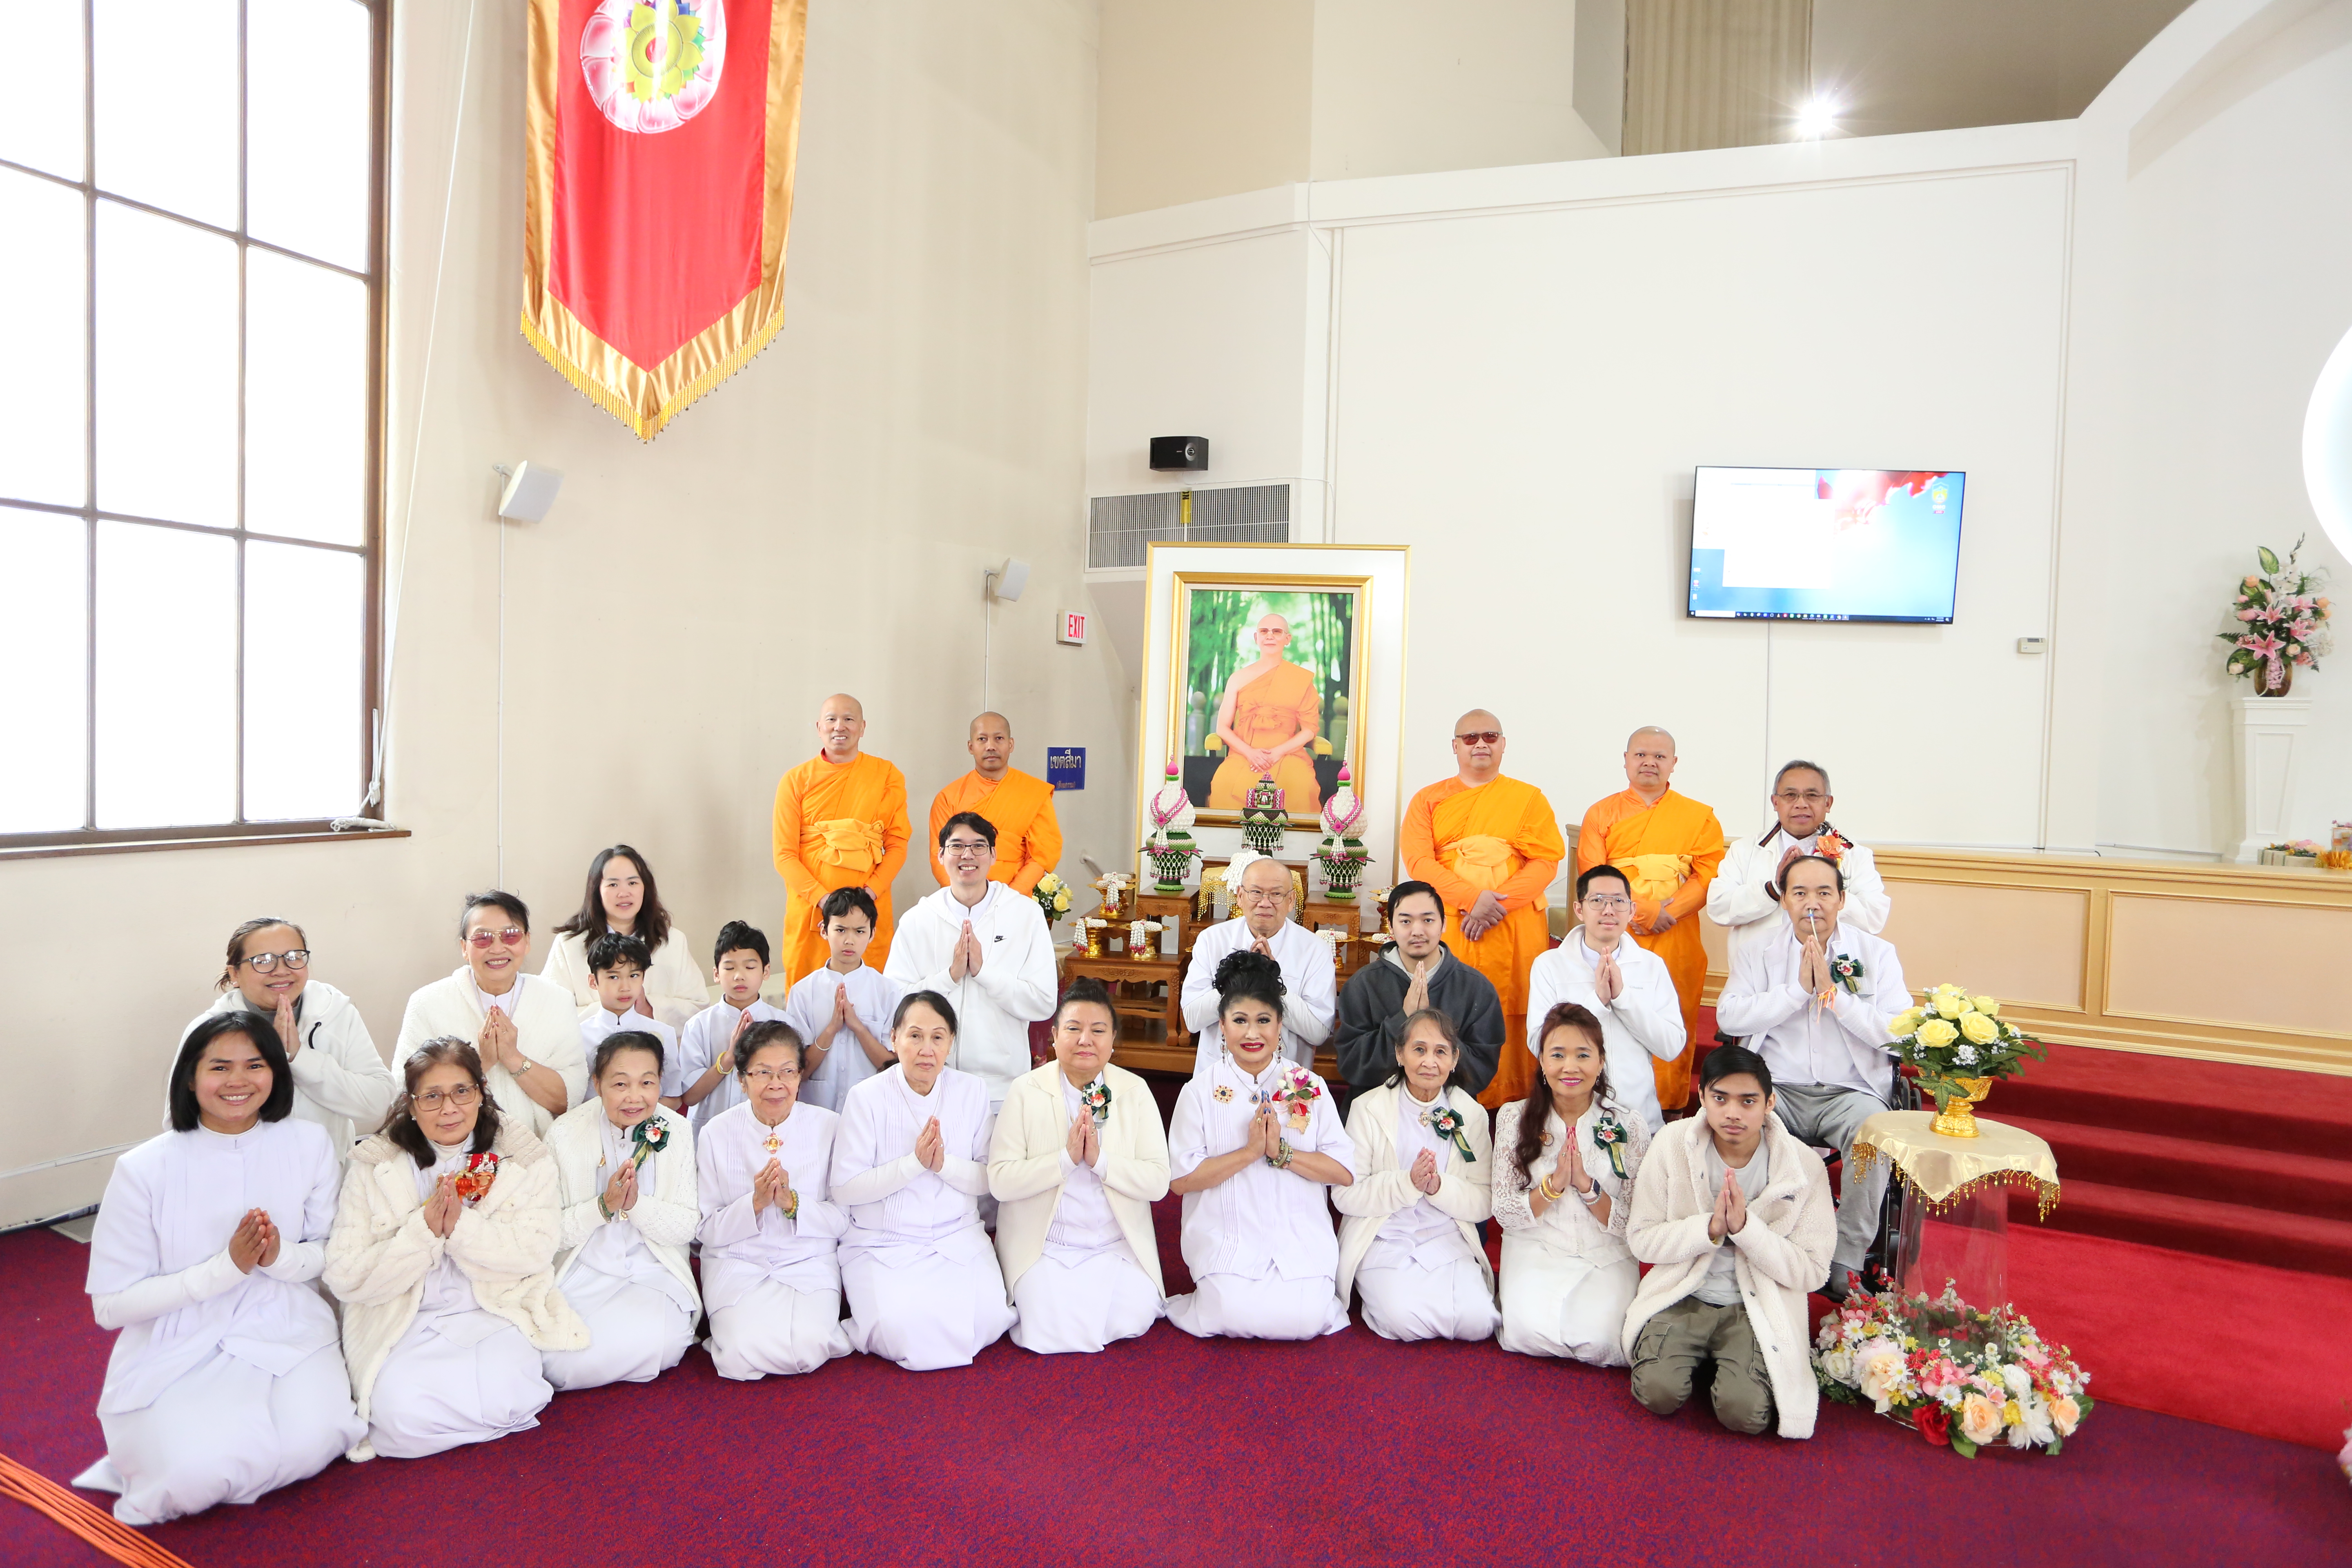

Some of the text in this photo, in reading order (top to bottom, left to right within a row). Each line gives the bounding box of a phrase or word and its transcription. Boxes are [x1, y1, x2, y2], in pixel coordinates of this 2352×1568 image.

[1068, 614, 1085, 639] EXIT
[1050, 748, 1081, 769] เขตสีมา
